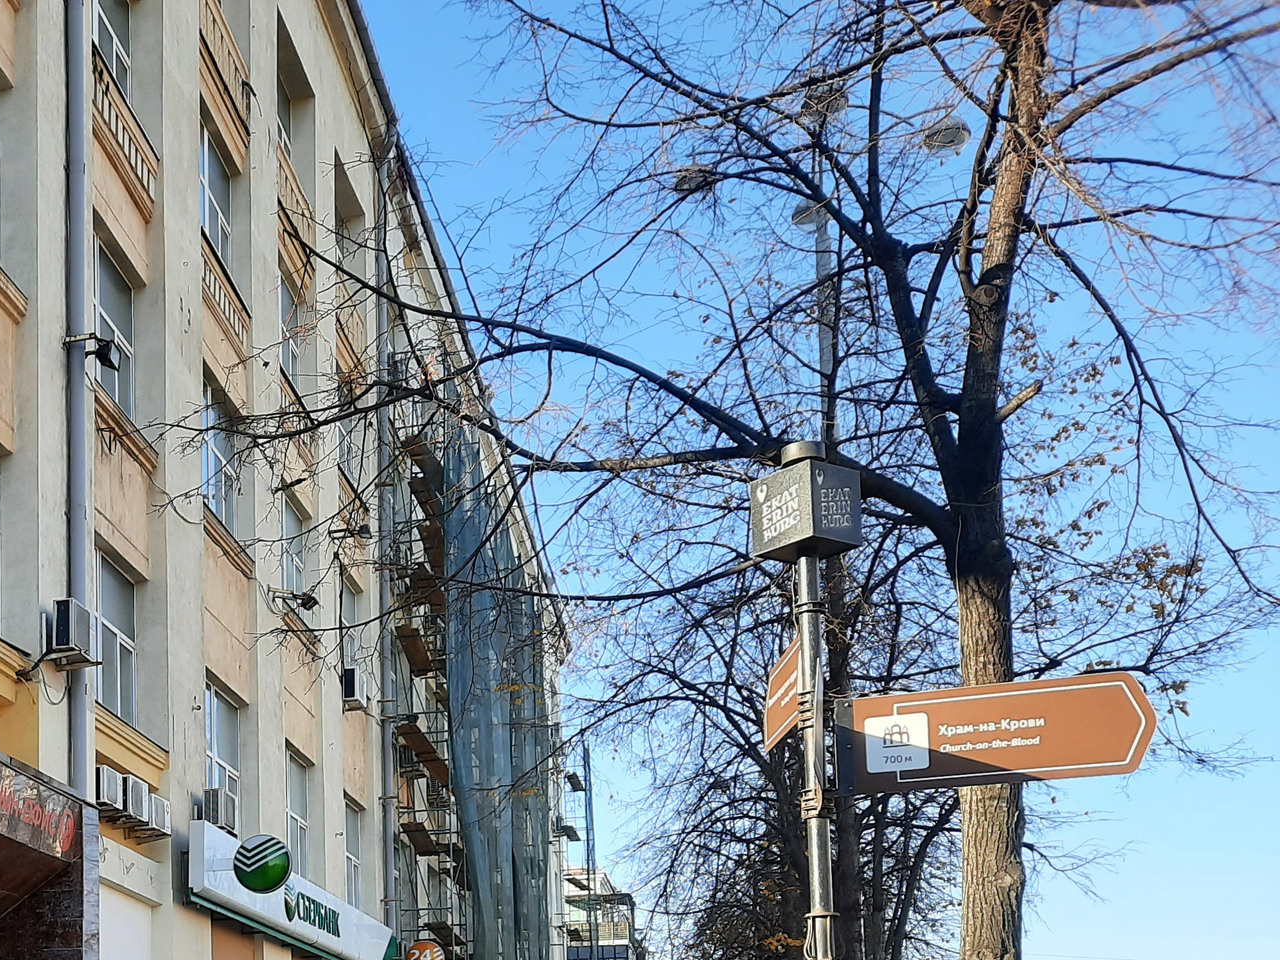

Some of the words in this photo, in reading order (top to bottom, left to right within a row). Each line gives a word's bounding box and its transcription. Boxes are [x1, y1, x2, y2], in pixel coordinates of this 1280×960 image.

[937, 717, 1045, 738] Храм-на-Крови
[939, 735, 1041, 754] Church-on-the-Blood
[883, 755, 903, 765] 700
[297, 891, 341, 938] СБЕРБАНК
